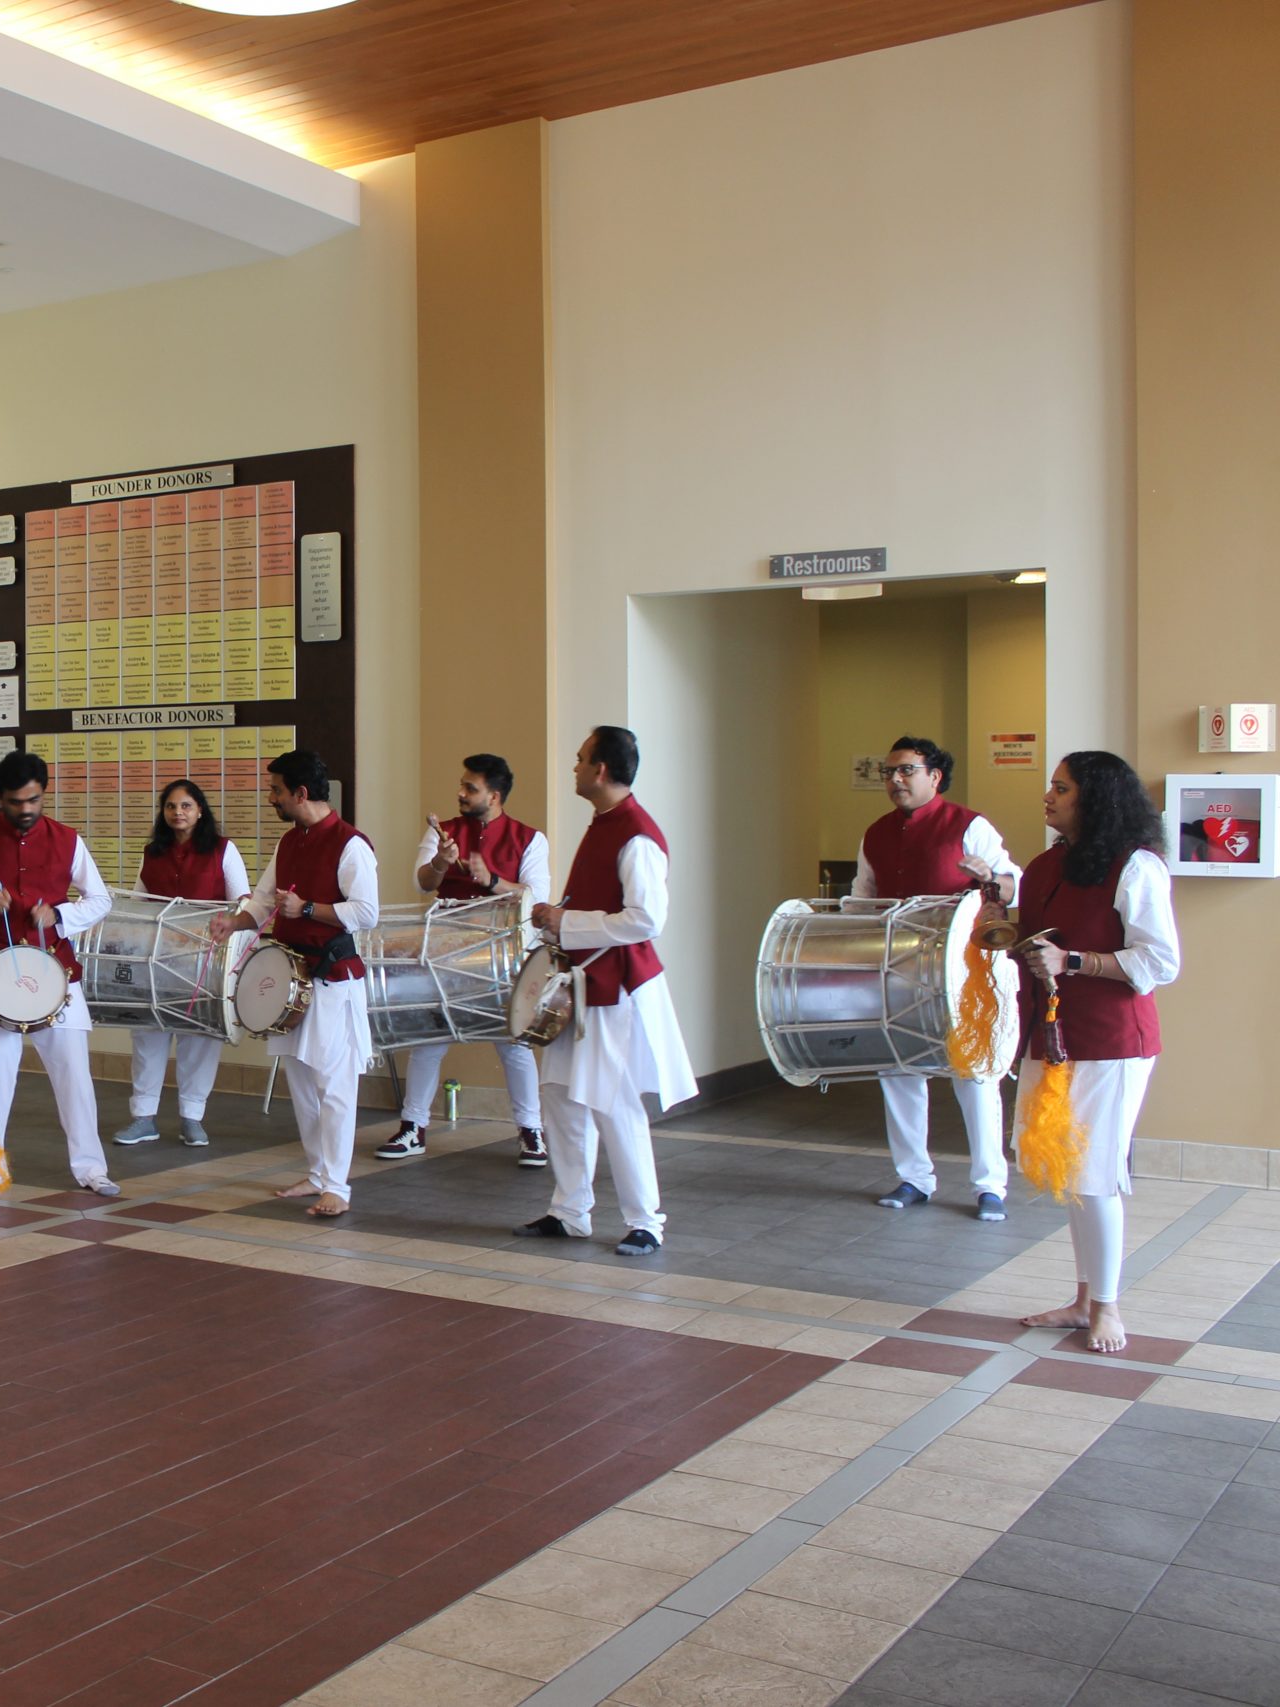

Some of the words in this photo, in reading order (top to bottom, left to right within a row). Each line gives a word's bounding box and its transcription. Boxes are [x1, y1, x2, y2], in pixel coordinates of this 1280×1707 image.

[91, 478, 152, 497] FOUNDER
[157, 471, 213, 489] DONORS
[783, 554, 872, 577] Restrooms
[81, 711, 163, 726] BENEFACTOR
[168, 709, 224, 724] DONORS
[1207, 804, 1233, 813] AED
